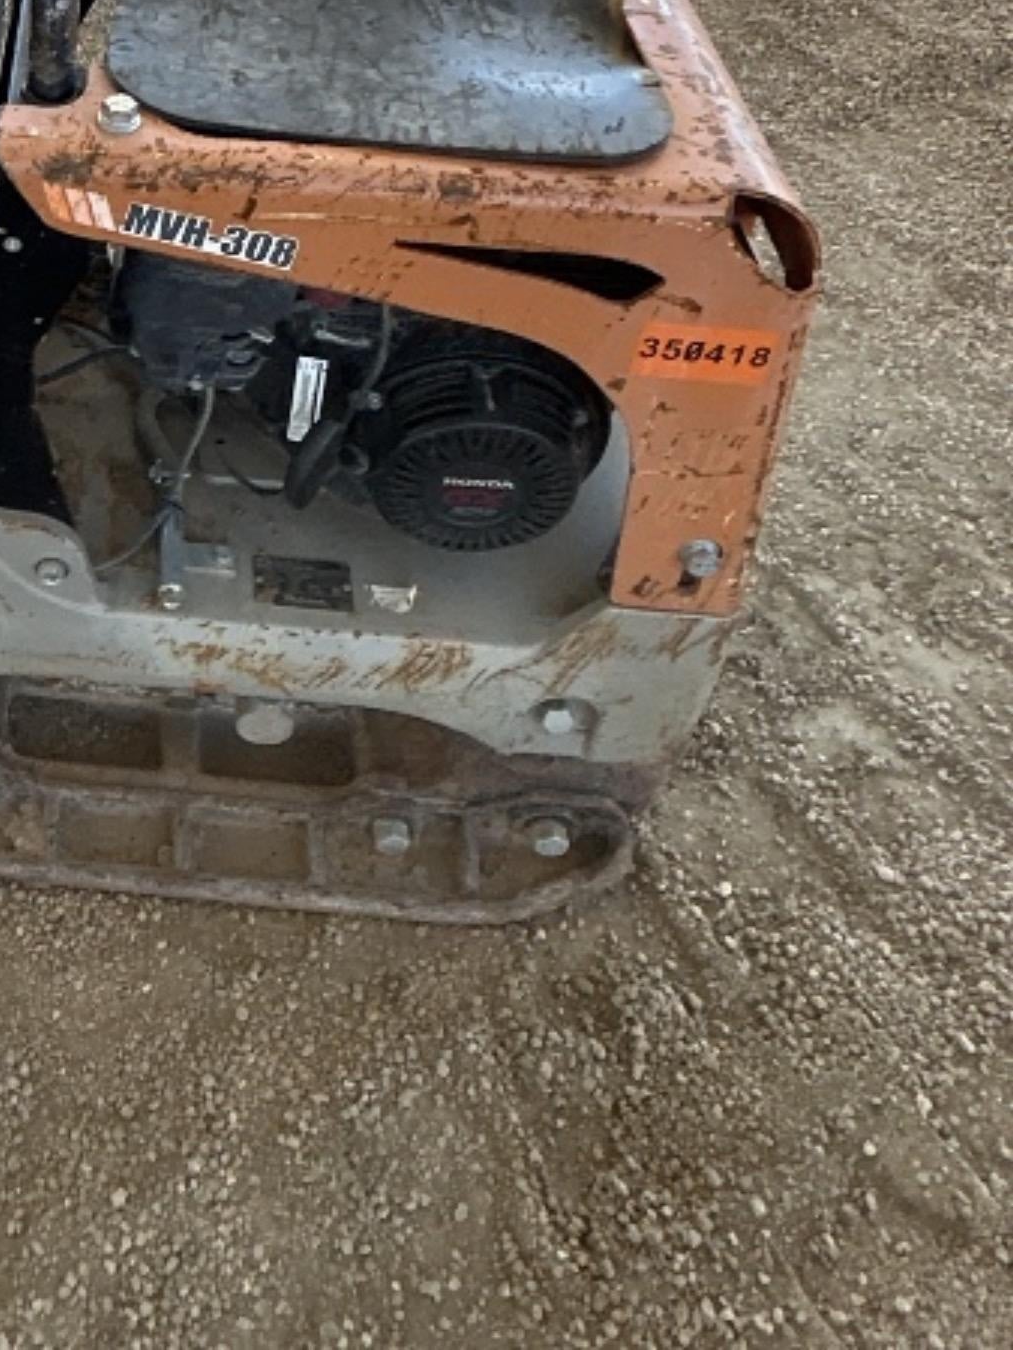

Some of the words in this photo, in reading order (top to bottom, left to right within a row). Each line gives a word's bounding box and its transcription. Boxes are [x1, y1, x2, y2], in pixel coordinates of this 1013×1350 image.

[121, 202, 298, 269] MVH-308
[639, 336, 772, 367] 350418
[443, 476, 515, 490] HONDA
